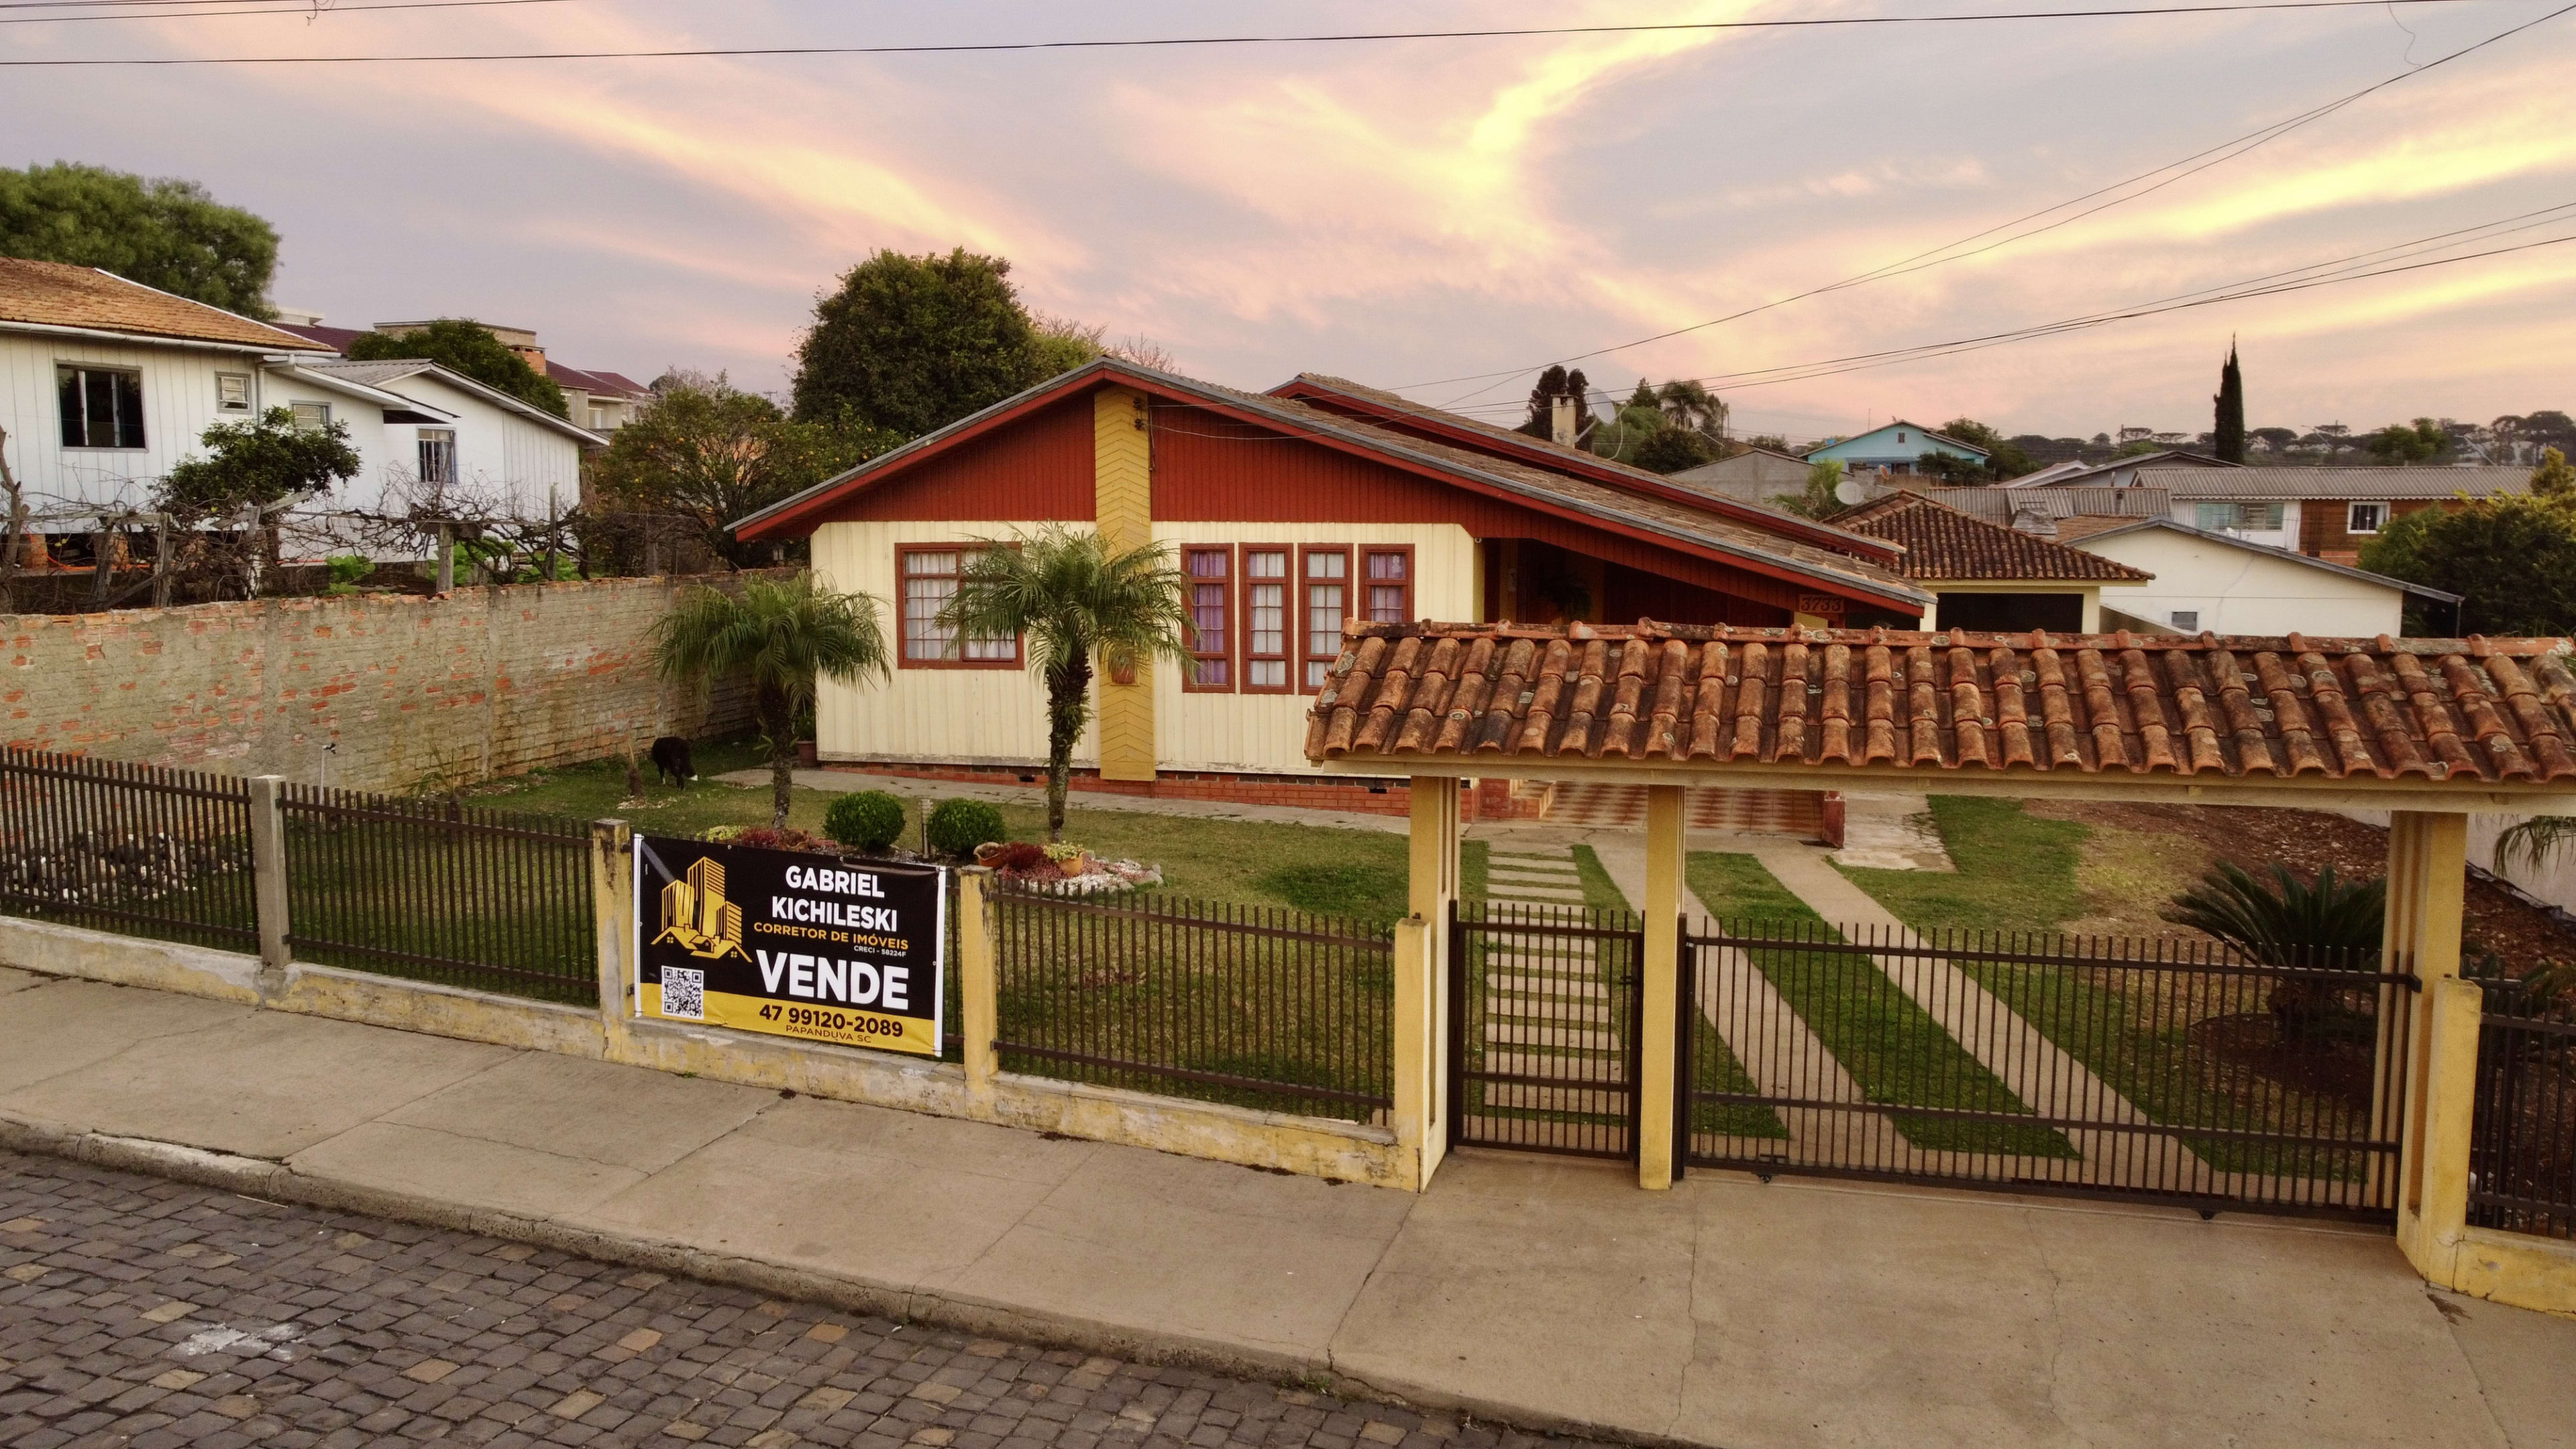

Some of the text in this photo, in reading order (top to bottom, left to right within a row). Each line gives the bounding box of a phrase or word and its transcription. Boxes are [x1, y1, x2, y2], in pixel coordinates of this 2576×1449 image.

[1801, 596, 1841, 611] 3733
[786, 865, 885, 898] GABRIEL
[772, 896, 897, 932] KICHILESKI
[753, 922, 908, 950] CORRETOR DE IMÓVEIS
[853, 945, 875, 954] CRECI
[755, 949, 909, 1010] VENDE
[759, 1004, 903, 1037] 47 99120-2089
[786, 1024, 871, 1043] PAPANDUVA SC
